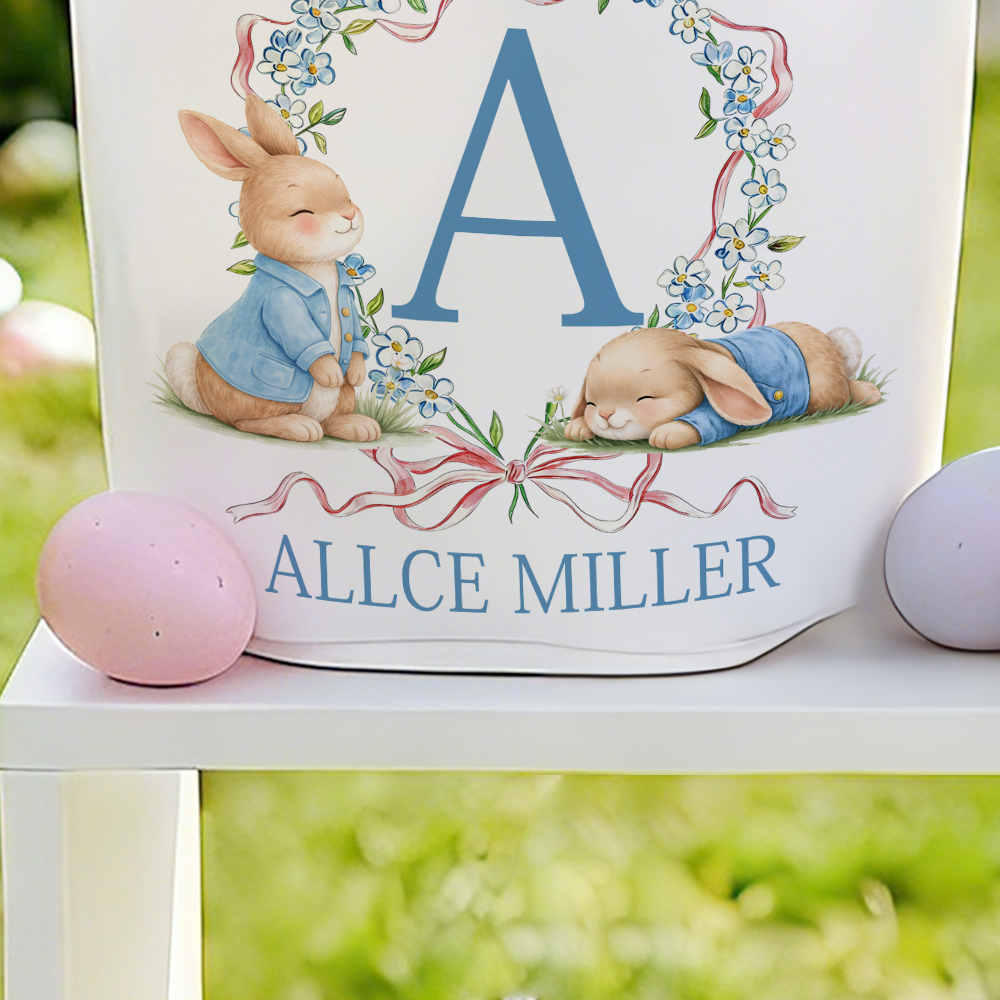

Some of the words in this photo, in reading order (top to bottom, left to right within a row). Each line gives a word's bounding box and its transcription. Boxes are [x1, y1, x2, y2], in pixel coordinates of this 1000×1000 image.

[391, 27, 645, 327] A
[265, 534, 489, 614] ALLCE
[512, 534, 781, 614] MILLER
